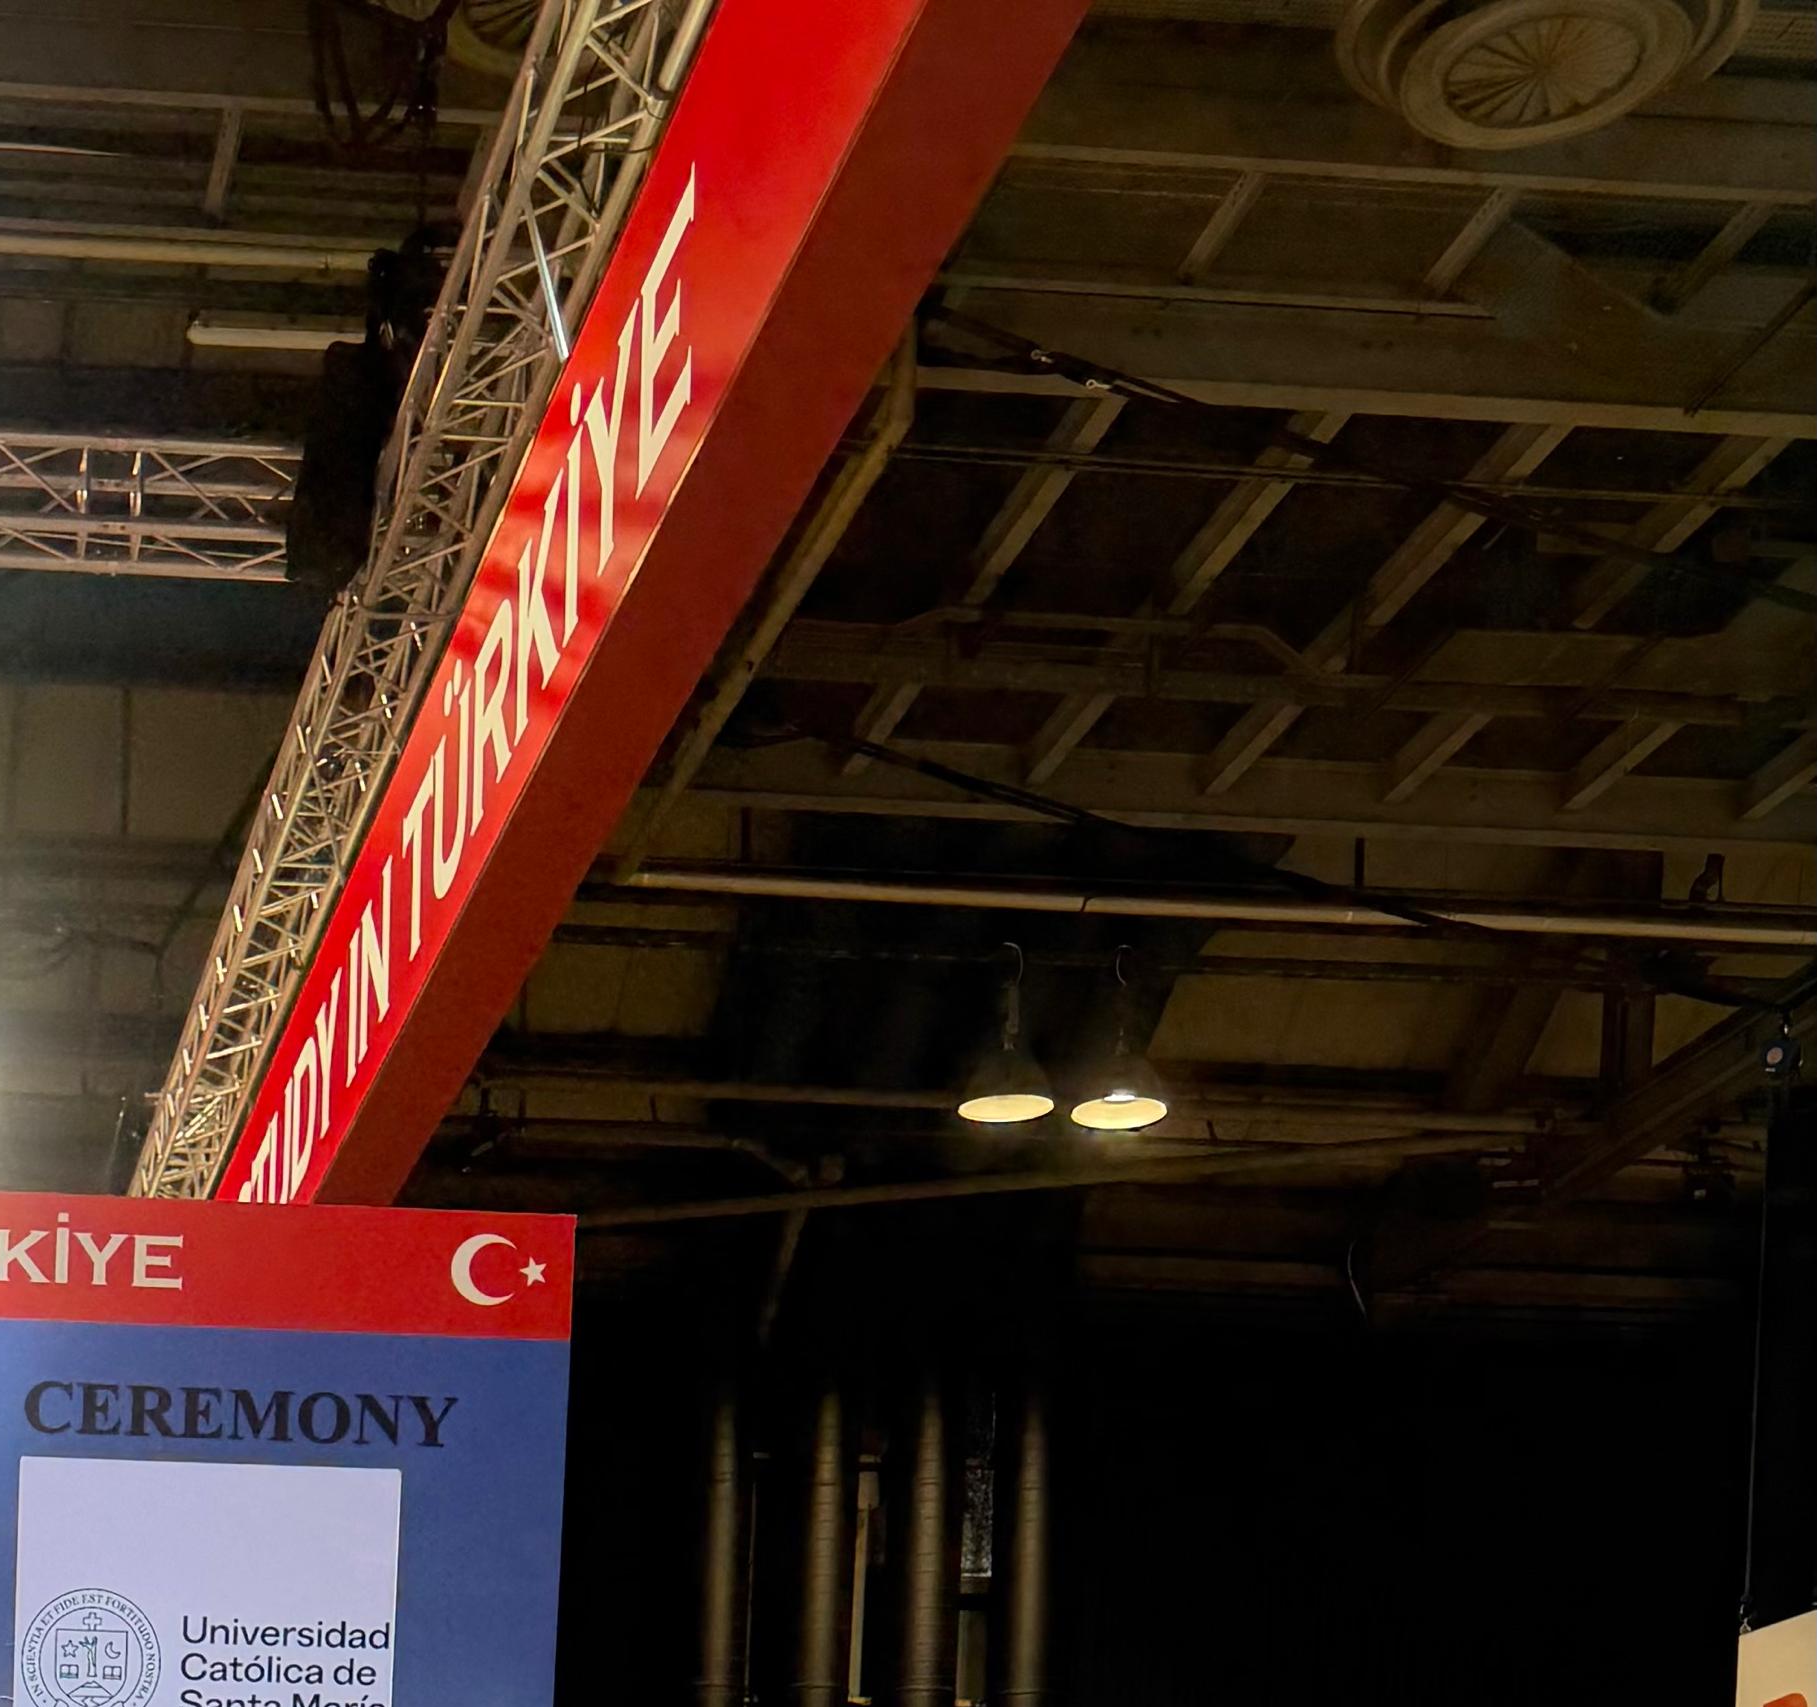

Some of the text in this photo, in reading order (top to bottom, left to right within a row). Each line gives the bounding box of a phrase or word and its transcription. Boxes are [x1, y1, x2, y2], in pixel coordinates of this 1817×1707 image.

[237, 162, 695, 1204] TUDY IN TÜRKİYE
[22, 1378, 458, 1448] CEREMONY
[182, 1615, 390, 1649] Universidad
[181, 1652, 376, 1685] Católica de
